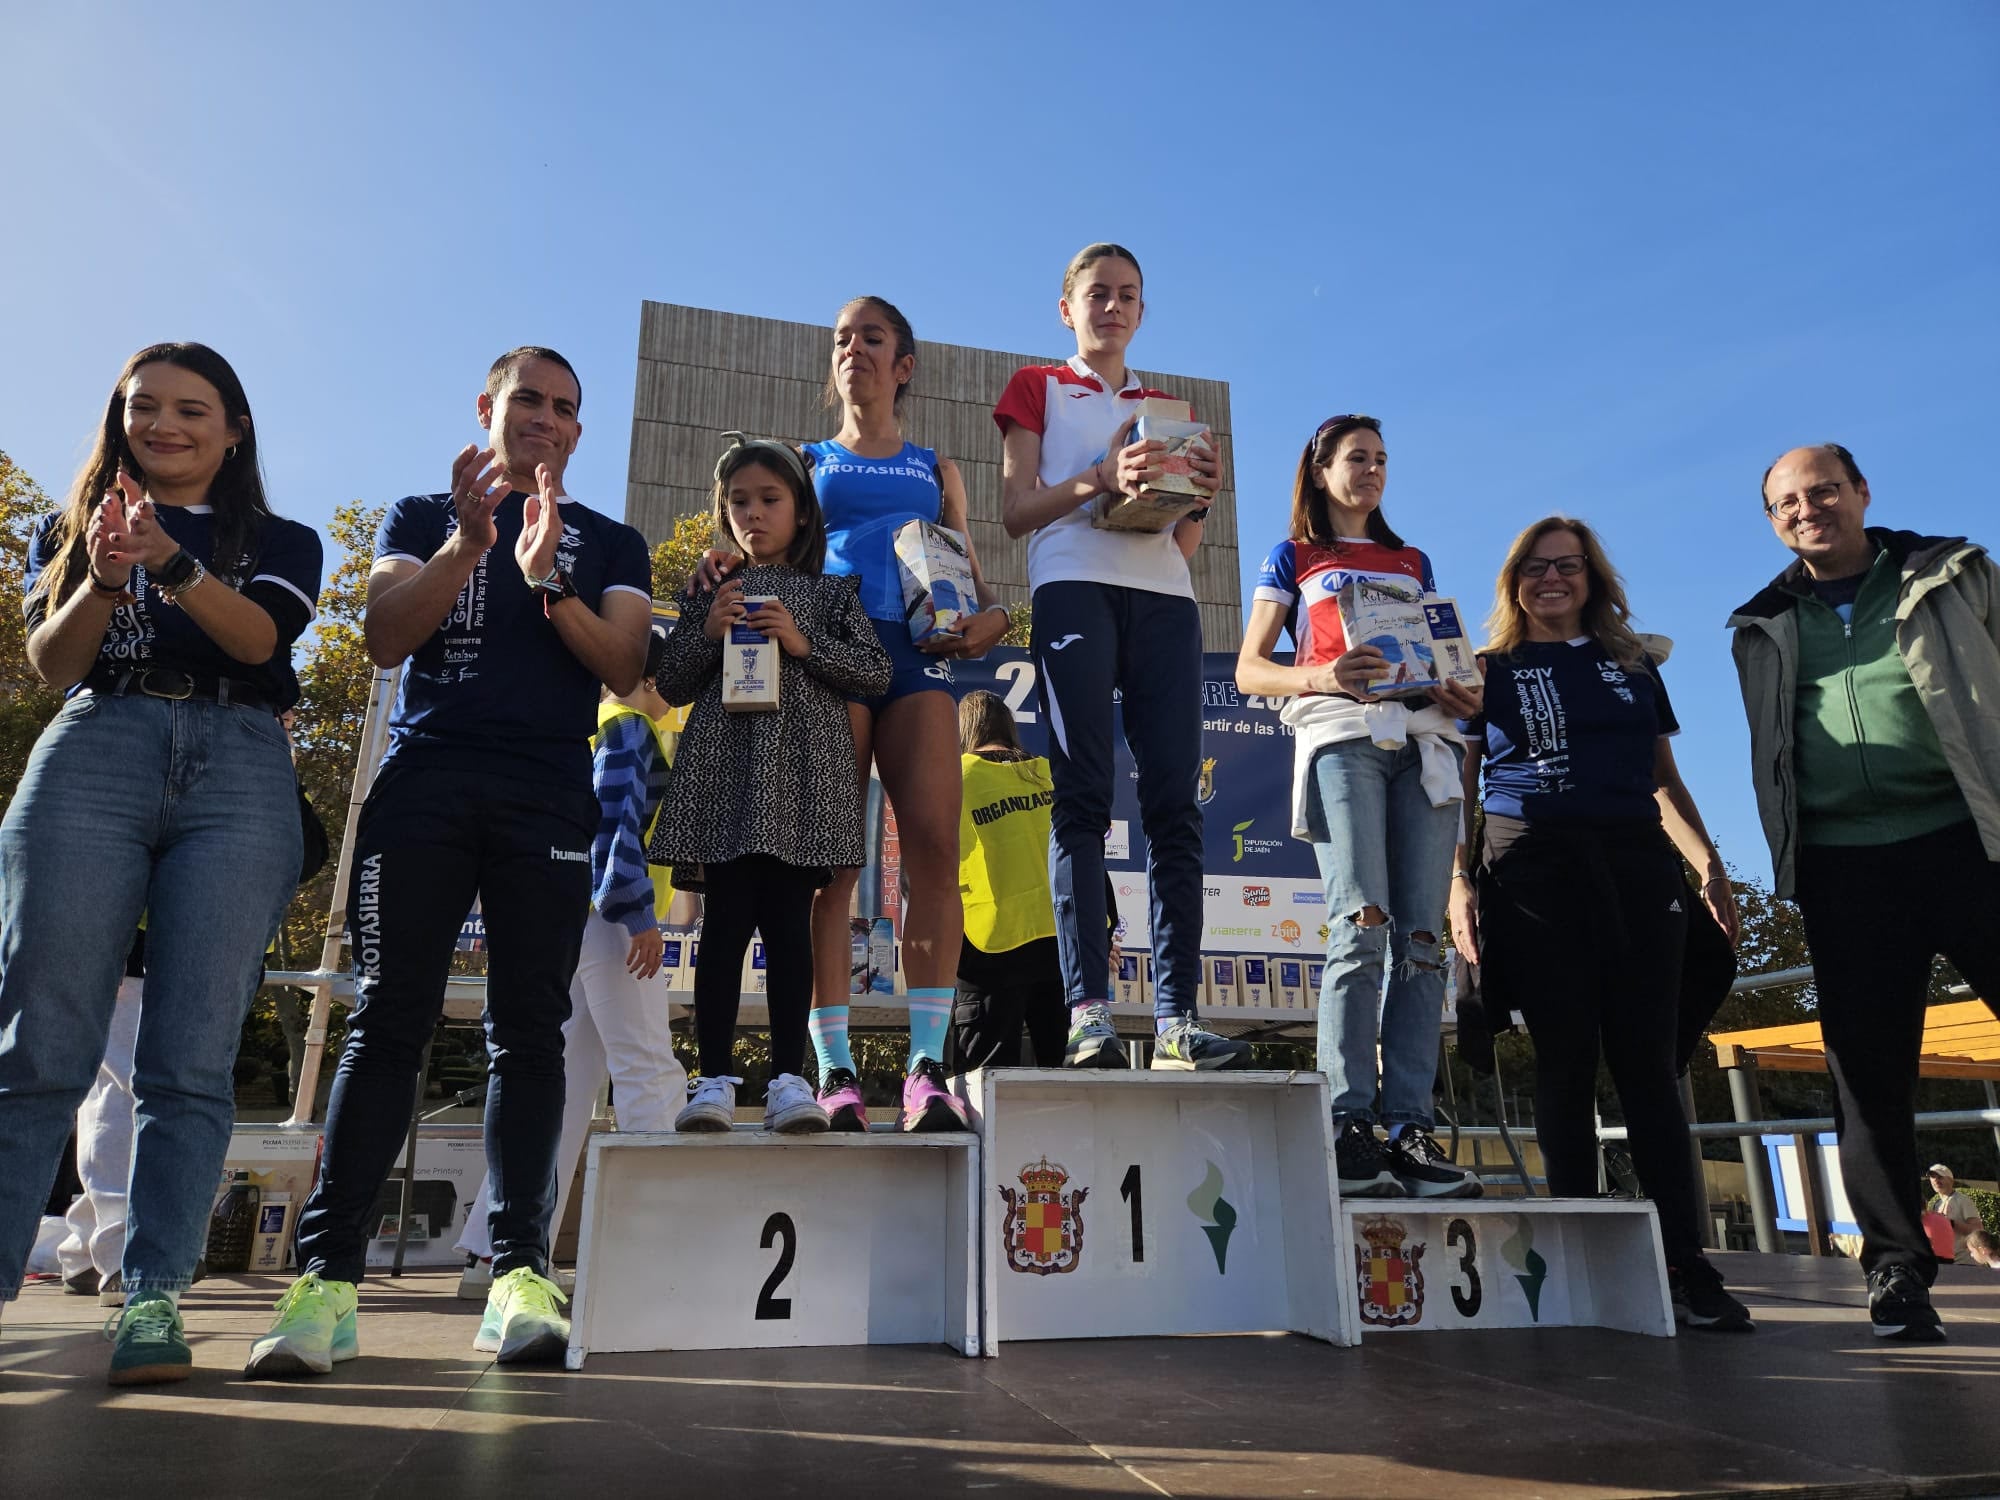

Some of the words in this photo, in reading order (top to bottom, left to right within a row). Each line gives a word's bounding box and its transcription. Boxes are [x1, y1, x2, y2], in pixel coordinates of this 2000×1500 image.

[819, 464, 937, 487] TROTASIERRA
[1426, 608, 1441, 624] 3
[995, 661, 1042, 724] 2
[1203, 718, 1232, 732] artir
[1235, 719, 1251, 733] de
[1254, 721, 1275, 736] las
[1279, 724, 1295, 737] 10
[1541, 721, 1553, 750] Gran
[1244, 839, 1283, 848] DIPUTACIÓN
[1202, 887, 1221, 897] TER
[358, 853, 383, 986] TROTASIERRA
[432, 1167, 463, 1177] Printing
[1120, 1164, 1144, 1263] 1
[754, 1211, 796, 1321] 2
[1446, 1218, 1481, 1318] 3
